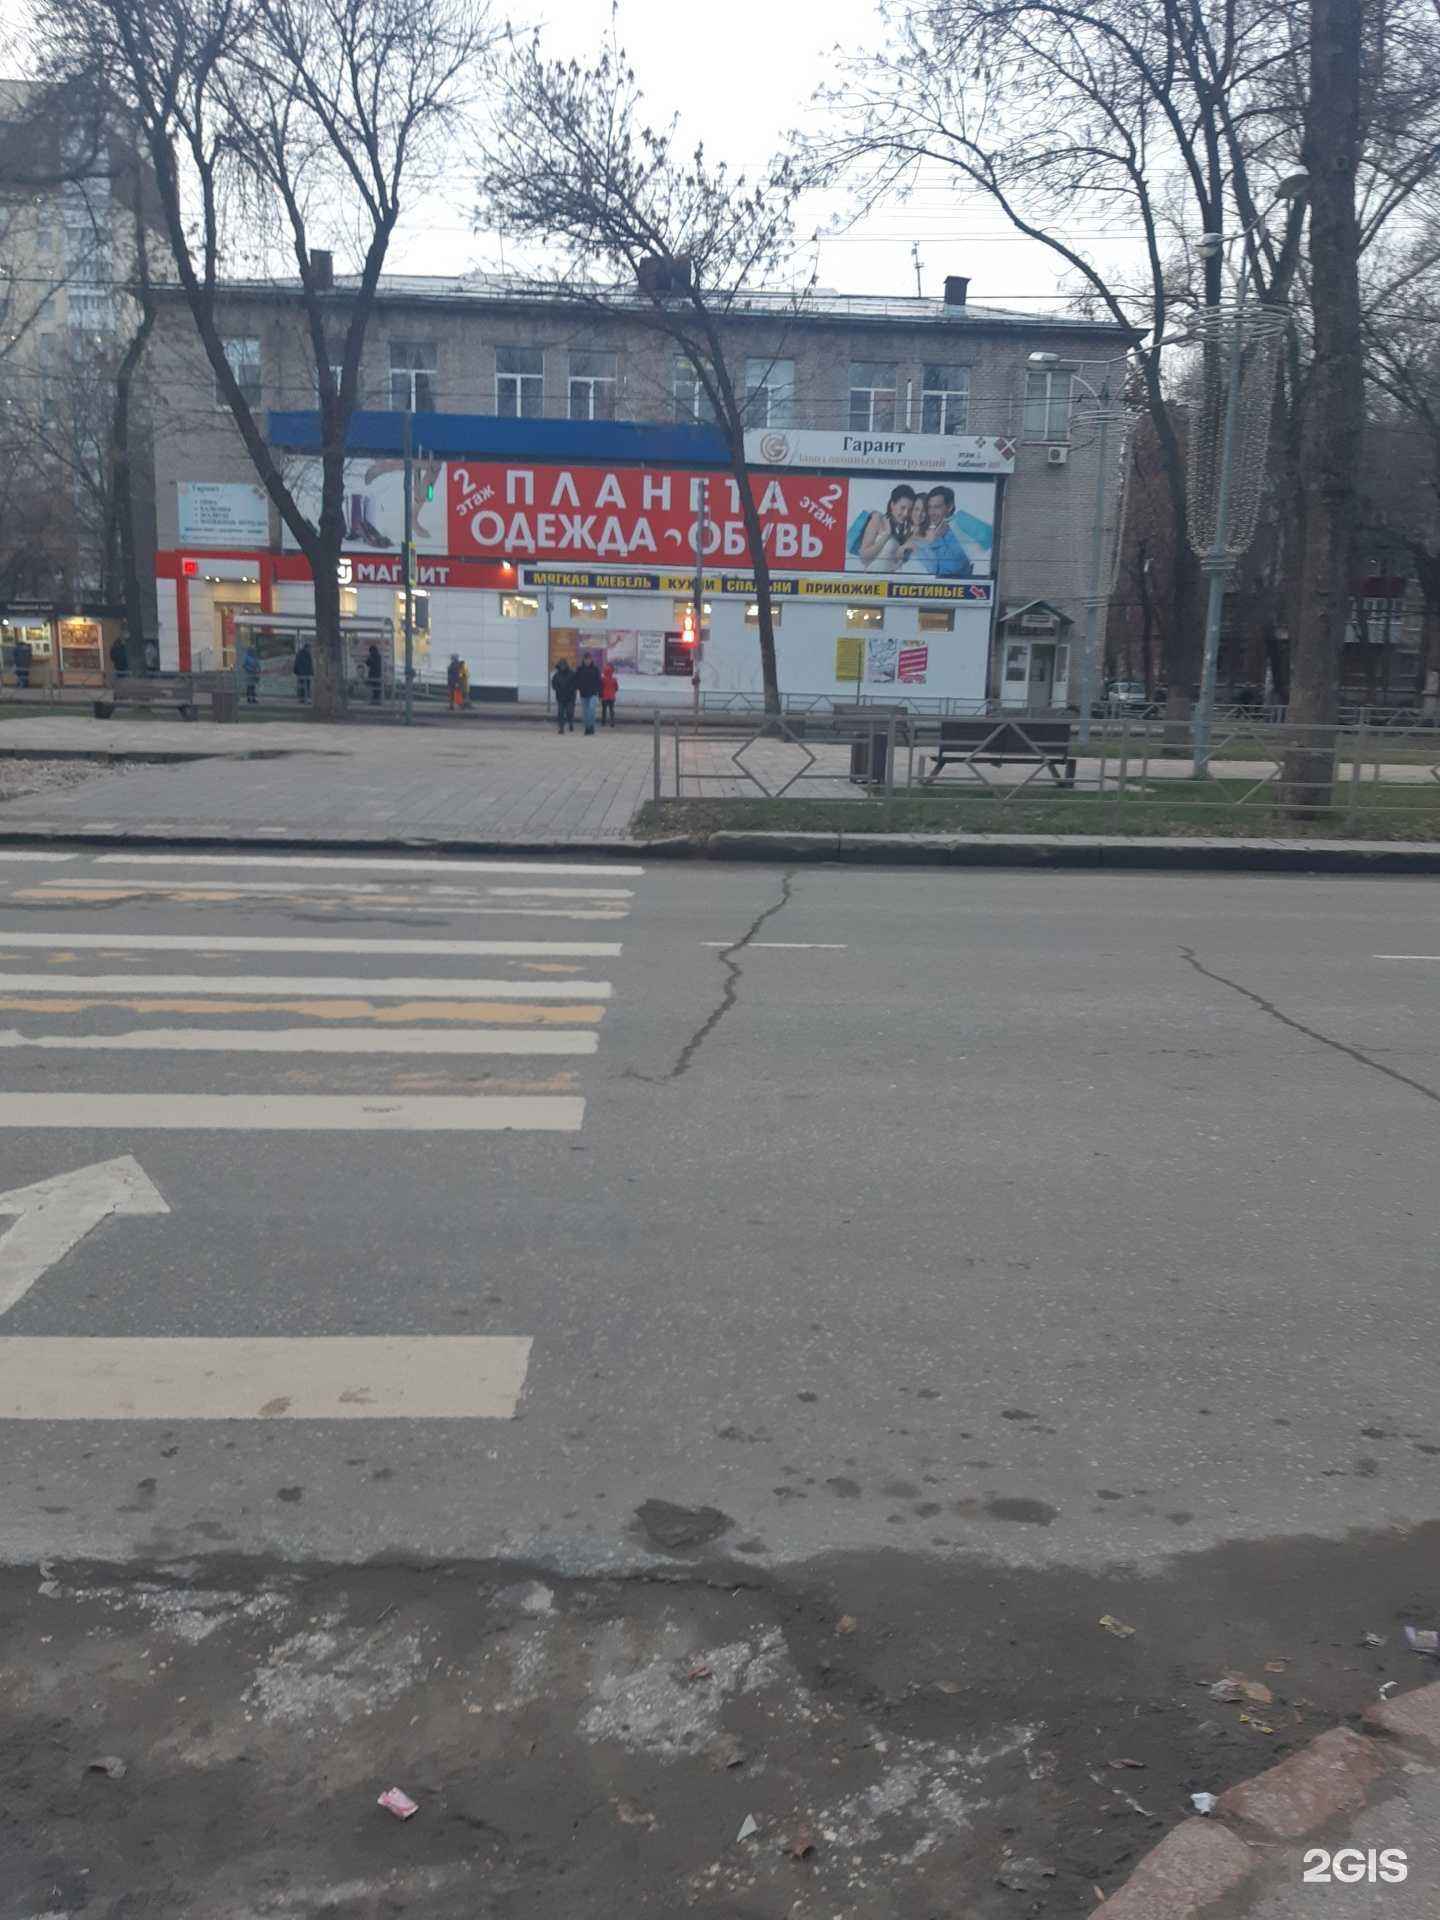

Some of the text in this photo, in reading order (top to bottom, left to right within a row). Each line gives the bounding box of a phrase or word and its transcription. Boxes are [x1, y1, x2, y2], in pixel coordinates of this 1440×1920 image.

[843, 436, 905, 455] Гарант
[453, 468, 476, 495] 2
[506, 469, 788, 515] ПЛАНЕТА
[456, 484, 496, 516] этаж
[818, 484, 842, 509] 2
[799, 496, 837, 531] этаж
[471, 510, 658, 557] ОДЕЖДА
[357, 563, 450, 584] МАГИТ
[533, 571, 965, 599] МЯГКАЯ МЕБЕЛЬ КУХИ СПАНИ ПРИХОЖИЕ ГОСТИНЫЕ
